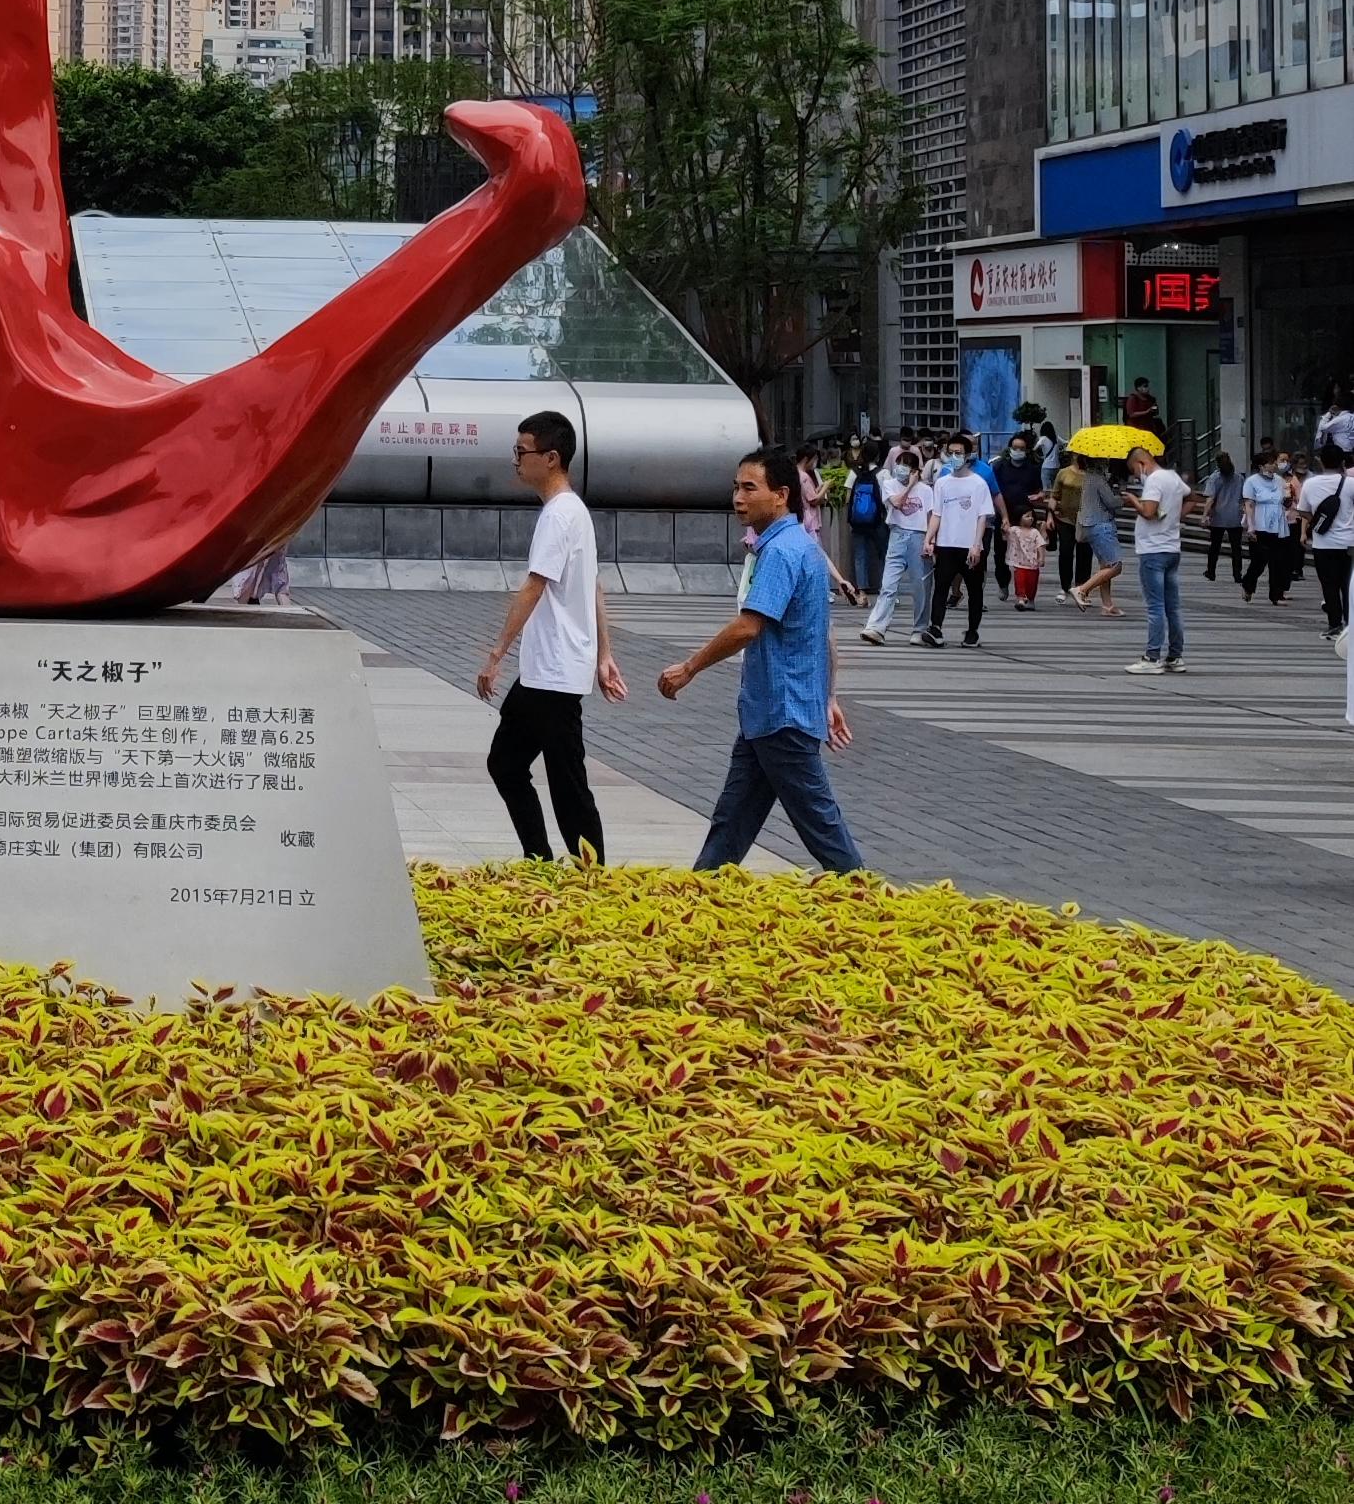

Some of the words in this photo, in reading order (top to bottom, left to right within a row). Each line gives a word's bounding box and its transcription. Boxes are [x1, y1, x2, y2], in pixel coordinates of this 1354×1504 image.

[442, 438, 479, 446] STEPPING
[37, 659, 163, 684] “天之椒子”
[279, 830, 316, 849] 收藏
[169, 887, 293, 907] 2015年7月21日
[298, 888, 317, 907] 立
